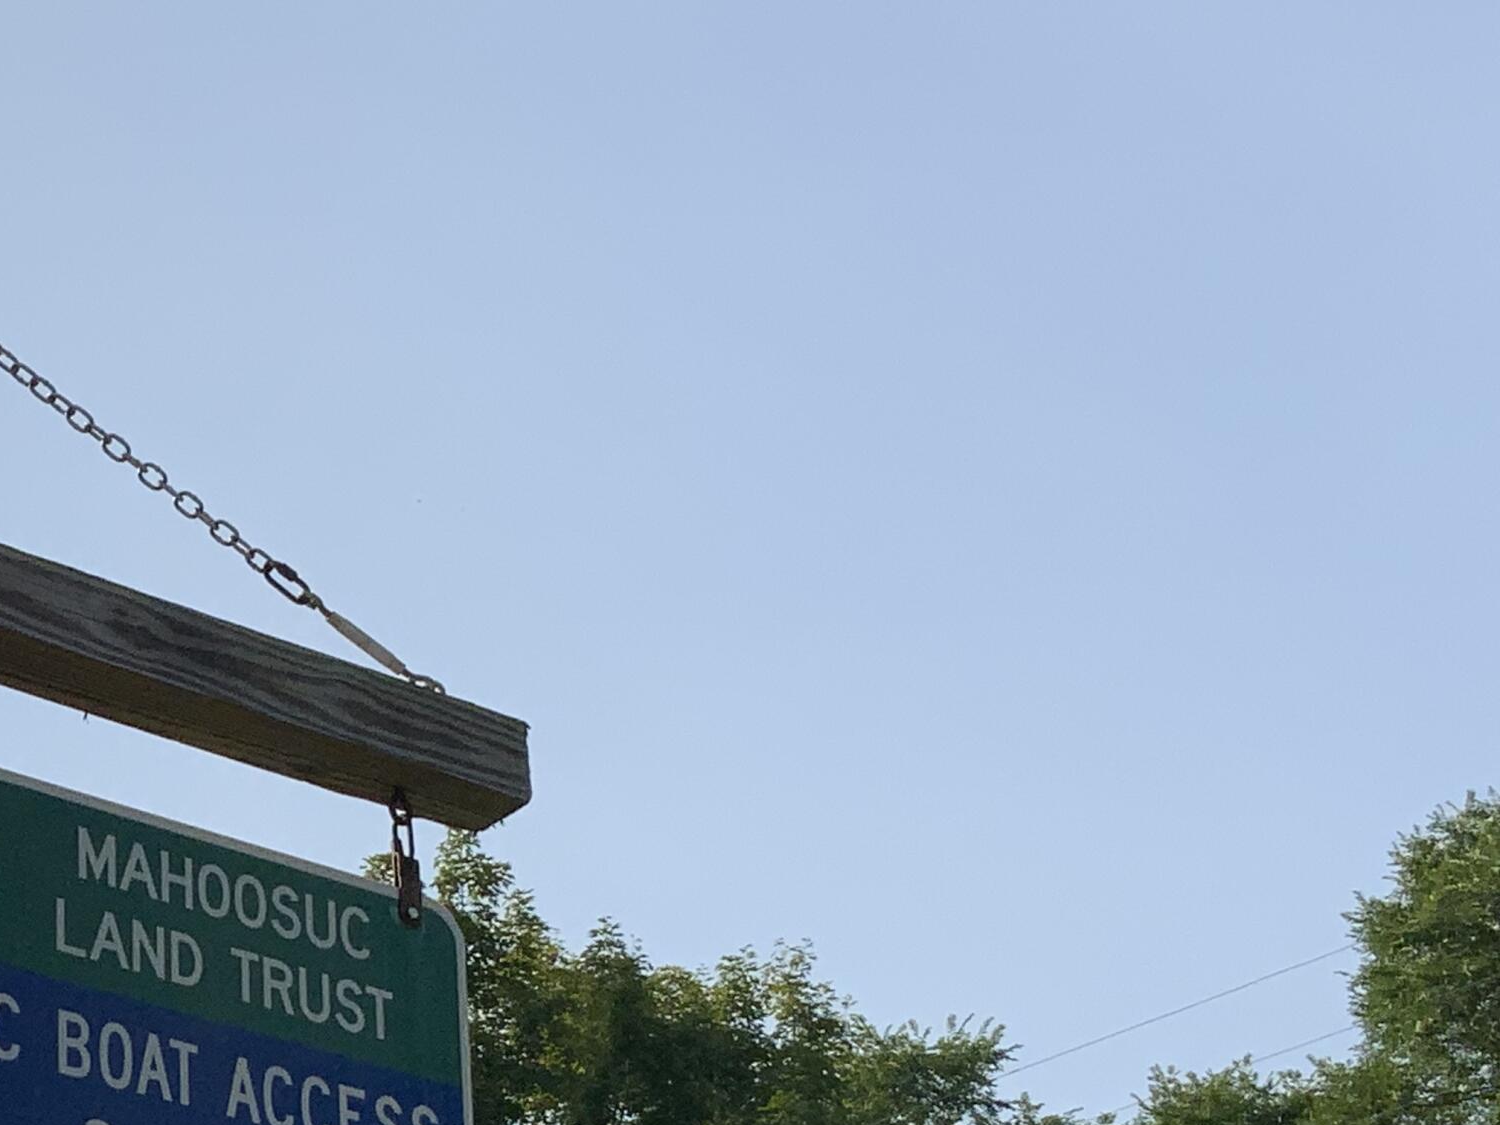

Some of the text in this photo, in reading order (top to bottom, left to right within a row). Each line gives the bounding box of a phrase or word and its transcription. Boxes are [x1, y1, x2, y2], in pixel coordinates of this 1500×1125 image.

[77, 827, 370, 960] MAHOOSUC
[54, 898, 393, 1040] LAND TRUST
[57, 1010, 198, 1106] BOAT
